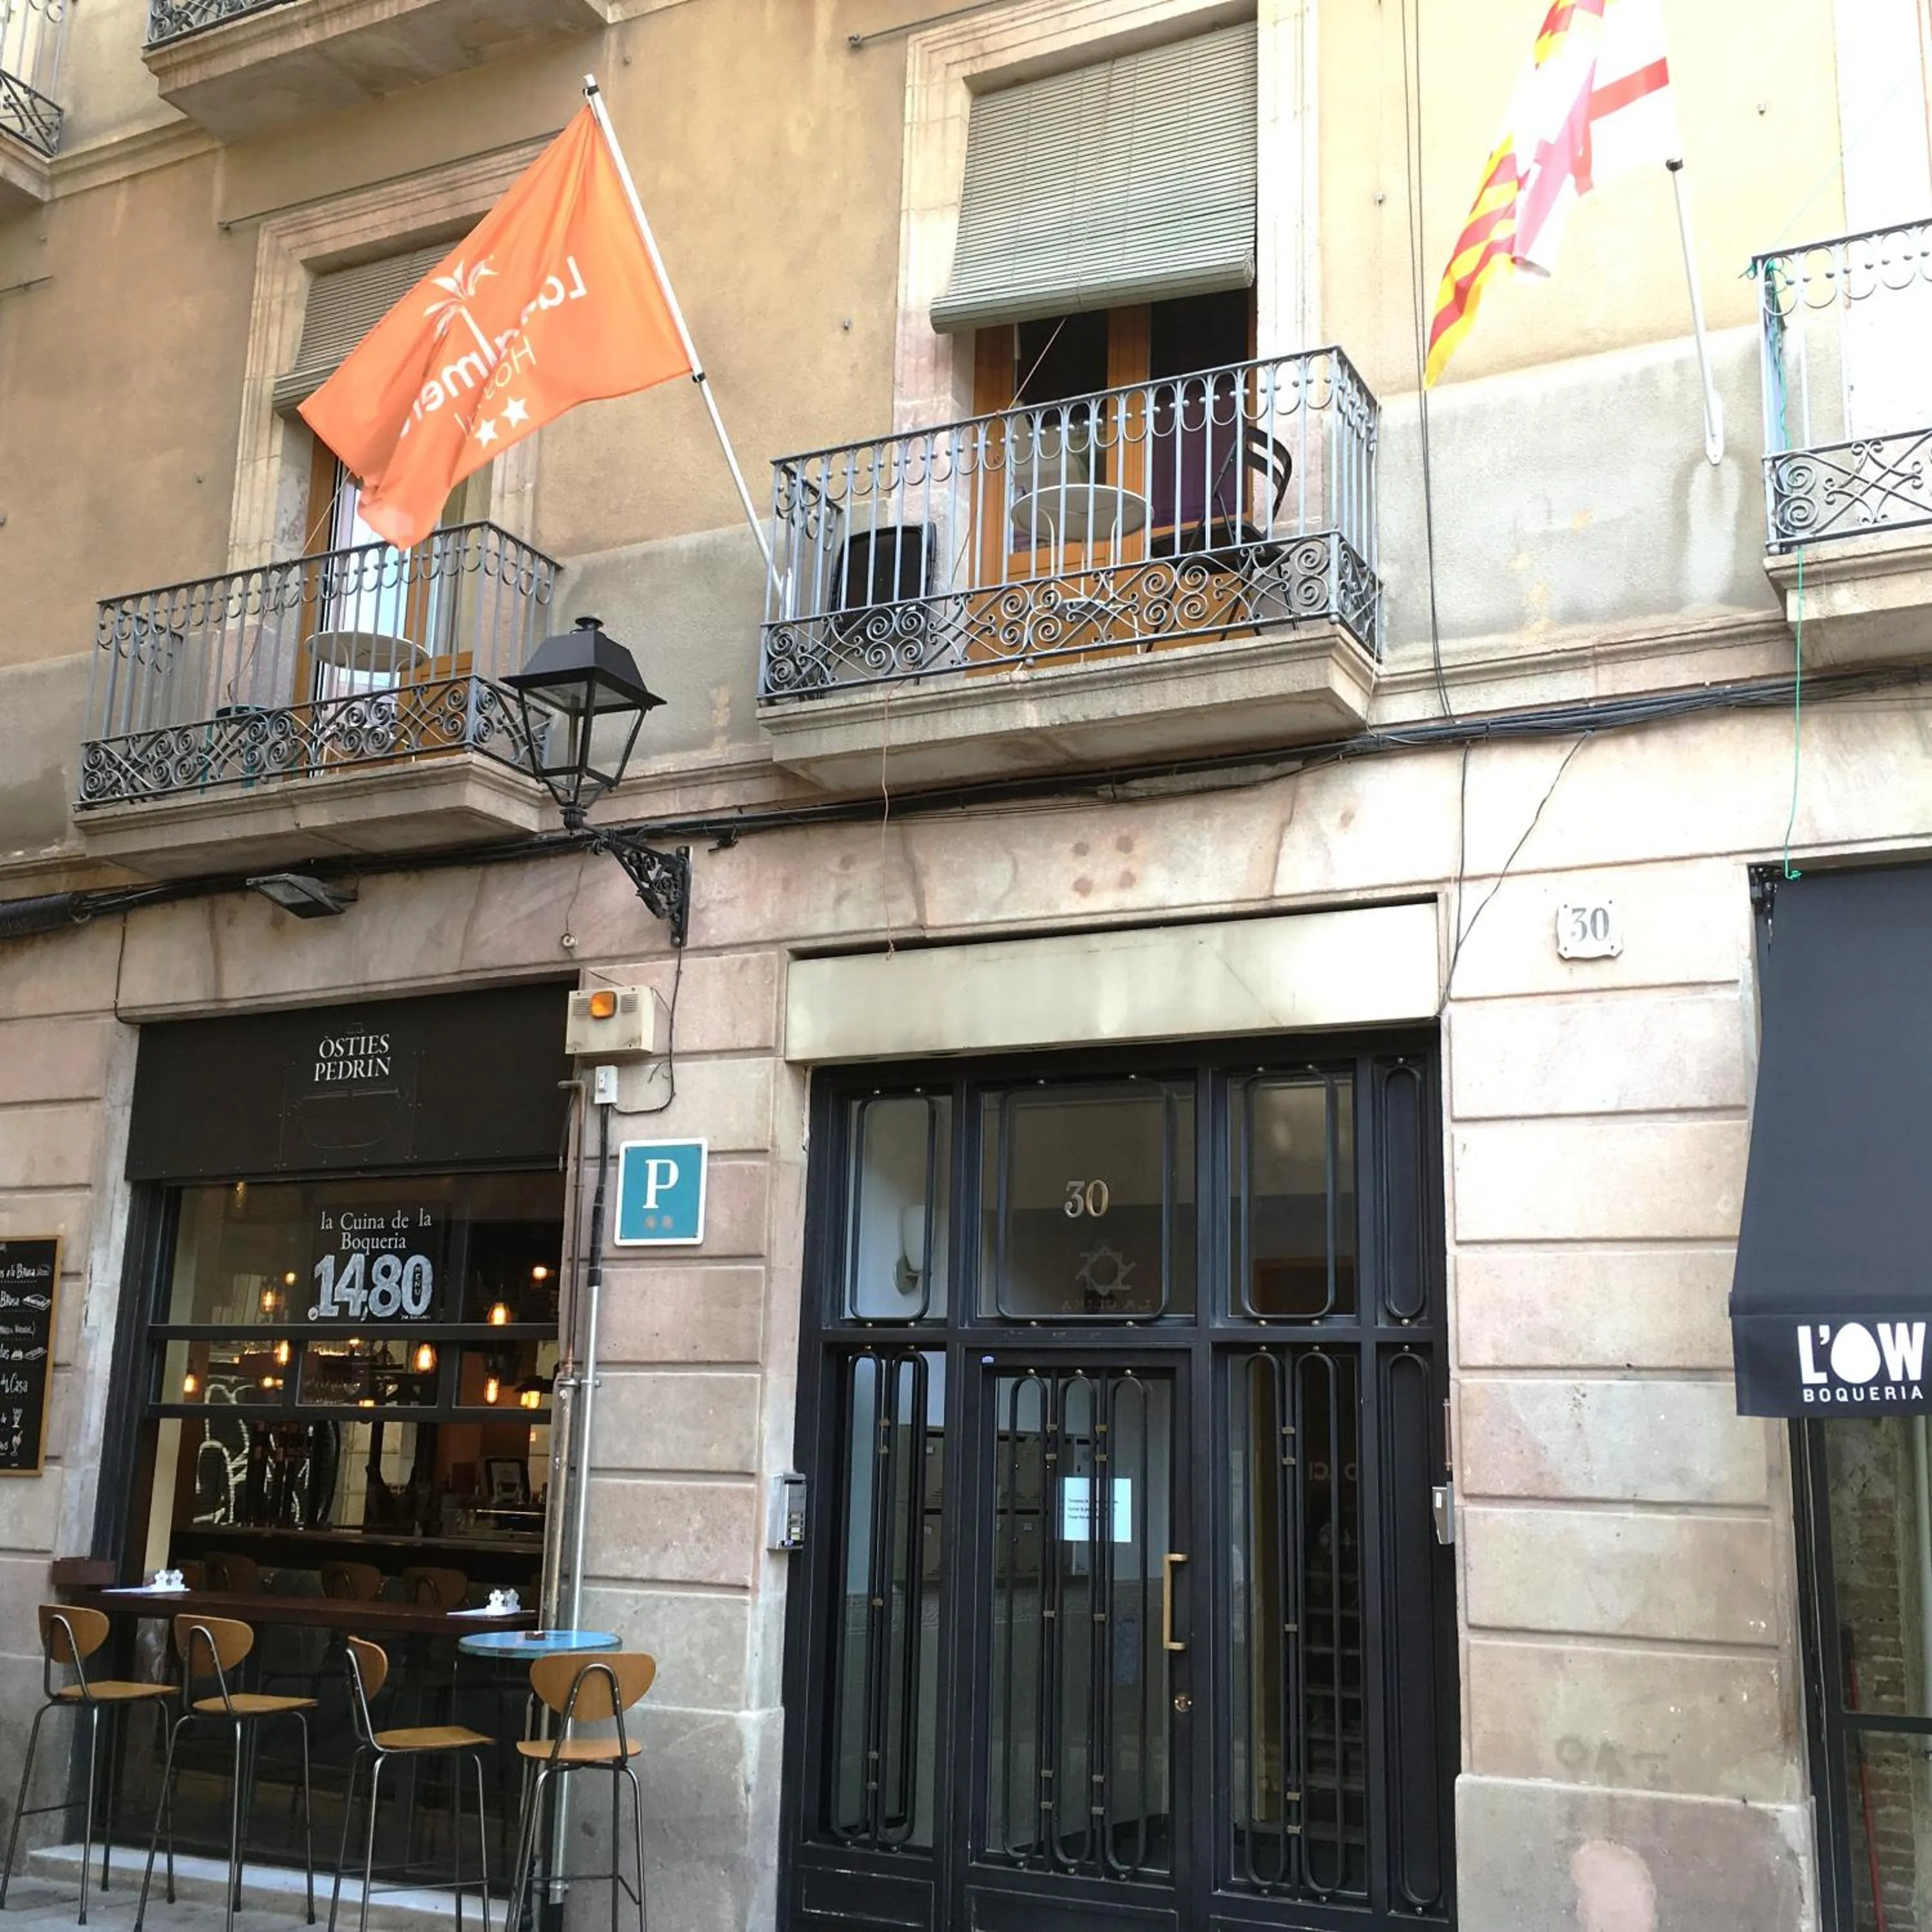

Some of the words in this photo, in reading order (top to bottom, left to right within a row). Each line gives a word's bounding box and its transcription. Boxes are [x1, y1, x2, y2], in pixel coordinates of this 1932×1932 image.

[1571, 907, 1609, 942] 30
[642, 1159, 679, 1209] P
[1064, 1179, 1109, 1218] 30
[321, 1211, 333, 1230] la
[340, 1212, 385, 1231] Cuina
[391, 1209, 410, 1229] de
[418, 1208, 432, 1227] la
[341, 1231, 407, 1255] Boqueria
[1803, 1386, 1923, 1403] BOQUERIA
